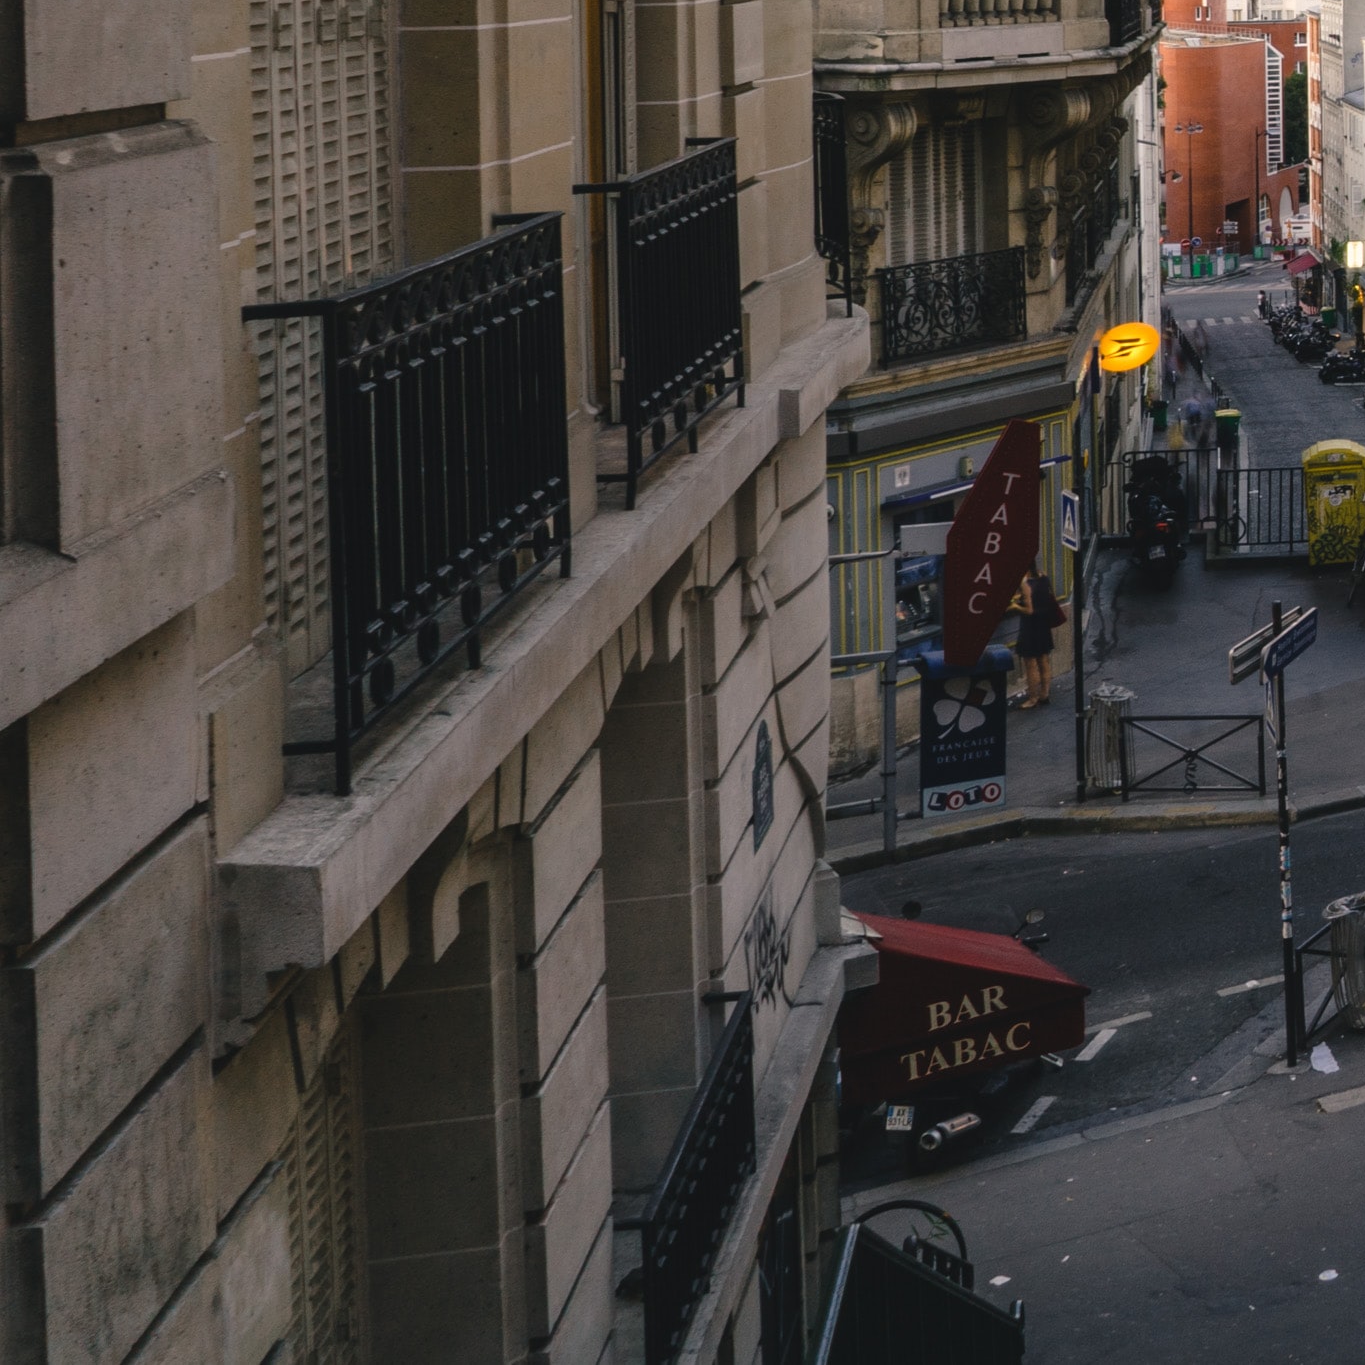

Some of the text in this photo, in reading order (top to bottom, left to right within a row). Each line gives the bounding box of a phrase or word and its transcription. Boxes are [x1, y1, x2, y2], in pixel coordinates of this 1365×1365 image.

[968, 472, 1021, 615] TABAC
[936, 749, 991, 764] DES JEUX
[928, 783, 1002, 812] LOTO
[926, 985, 1008, 1032] BAR
[900, 1021, 1032, 1081] TABAC
